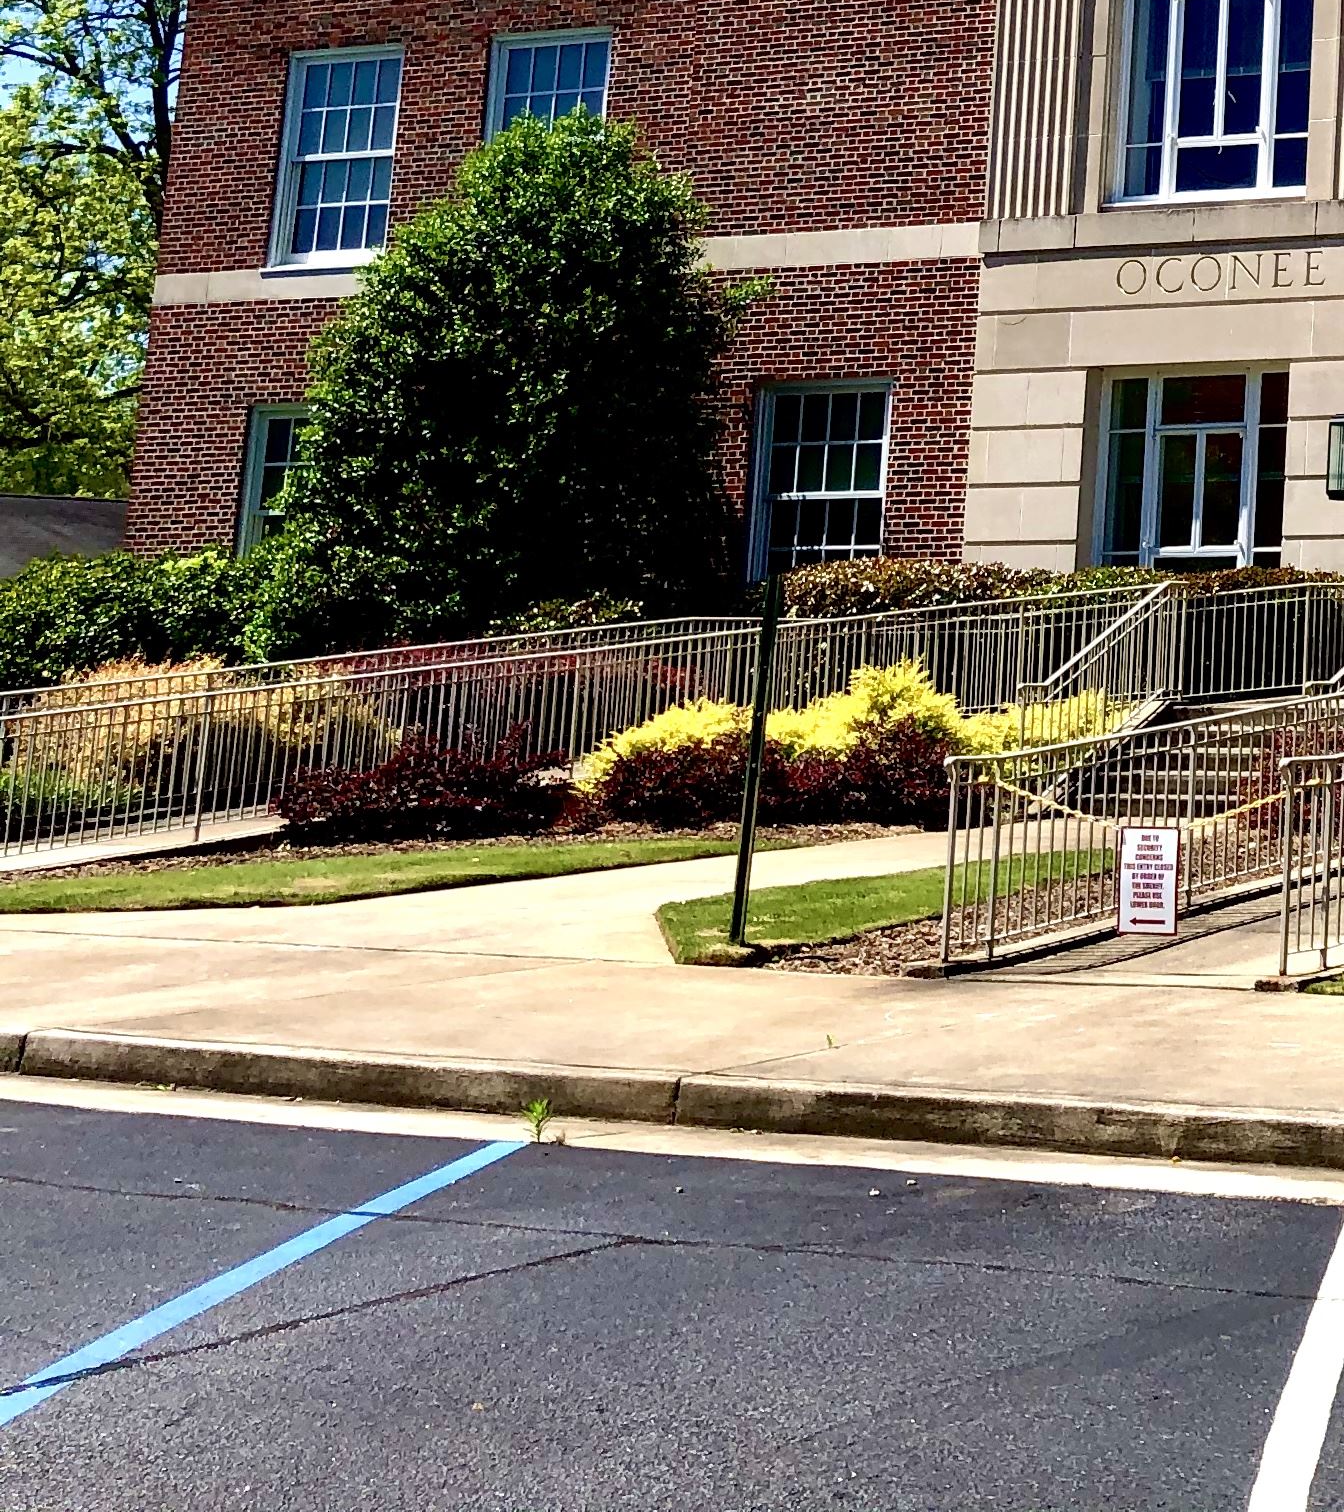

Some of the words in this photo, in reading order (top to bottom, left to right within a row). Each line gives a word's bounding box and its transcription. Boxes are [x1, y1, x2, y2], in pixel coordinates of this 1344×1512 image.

[1116, 250, 1326, 295] OCONEE
[1141, 834, 1152, 842] DUE
[1153, 834, 1160, 842] TO
[1154, 863, 1174, 871] CLOSED
[1131, 872, 1139, 880] BY
[1140, 872, 1156, 880] ORDER
[1132, 891, 1152, 899] PLEASE
